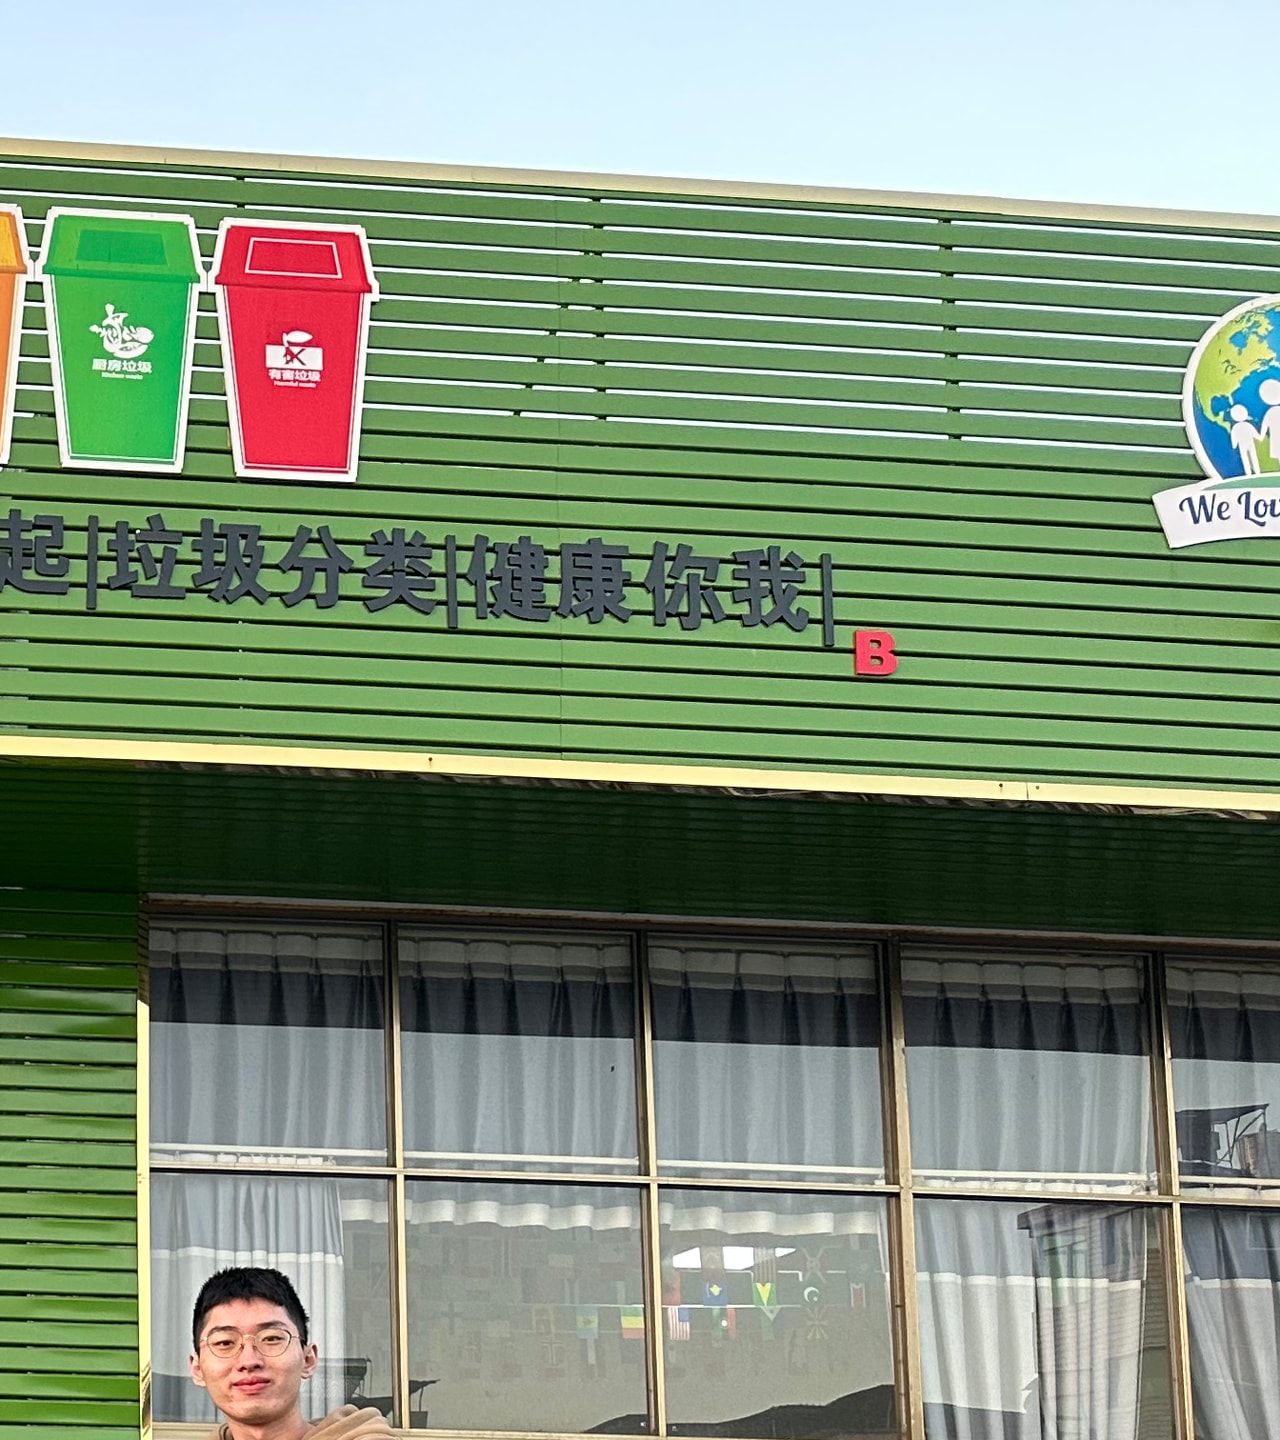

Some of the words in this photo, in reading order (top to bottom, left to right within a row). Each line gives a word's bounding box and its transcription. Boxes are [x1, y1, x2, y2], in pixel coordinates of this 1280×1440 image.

[92, 358, 152, 374] 厨房垃圾
[268, 369, 321, 383] 有害垃圾
[1179, 493, 1231, 525] We
[854, 628, 898, 677] B
